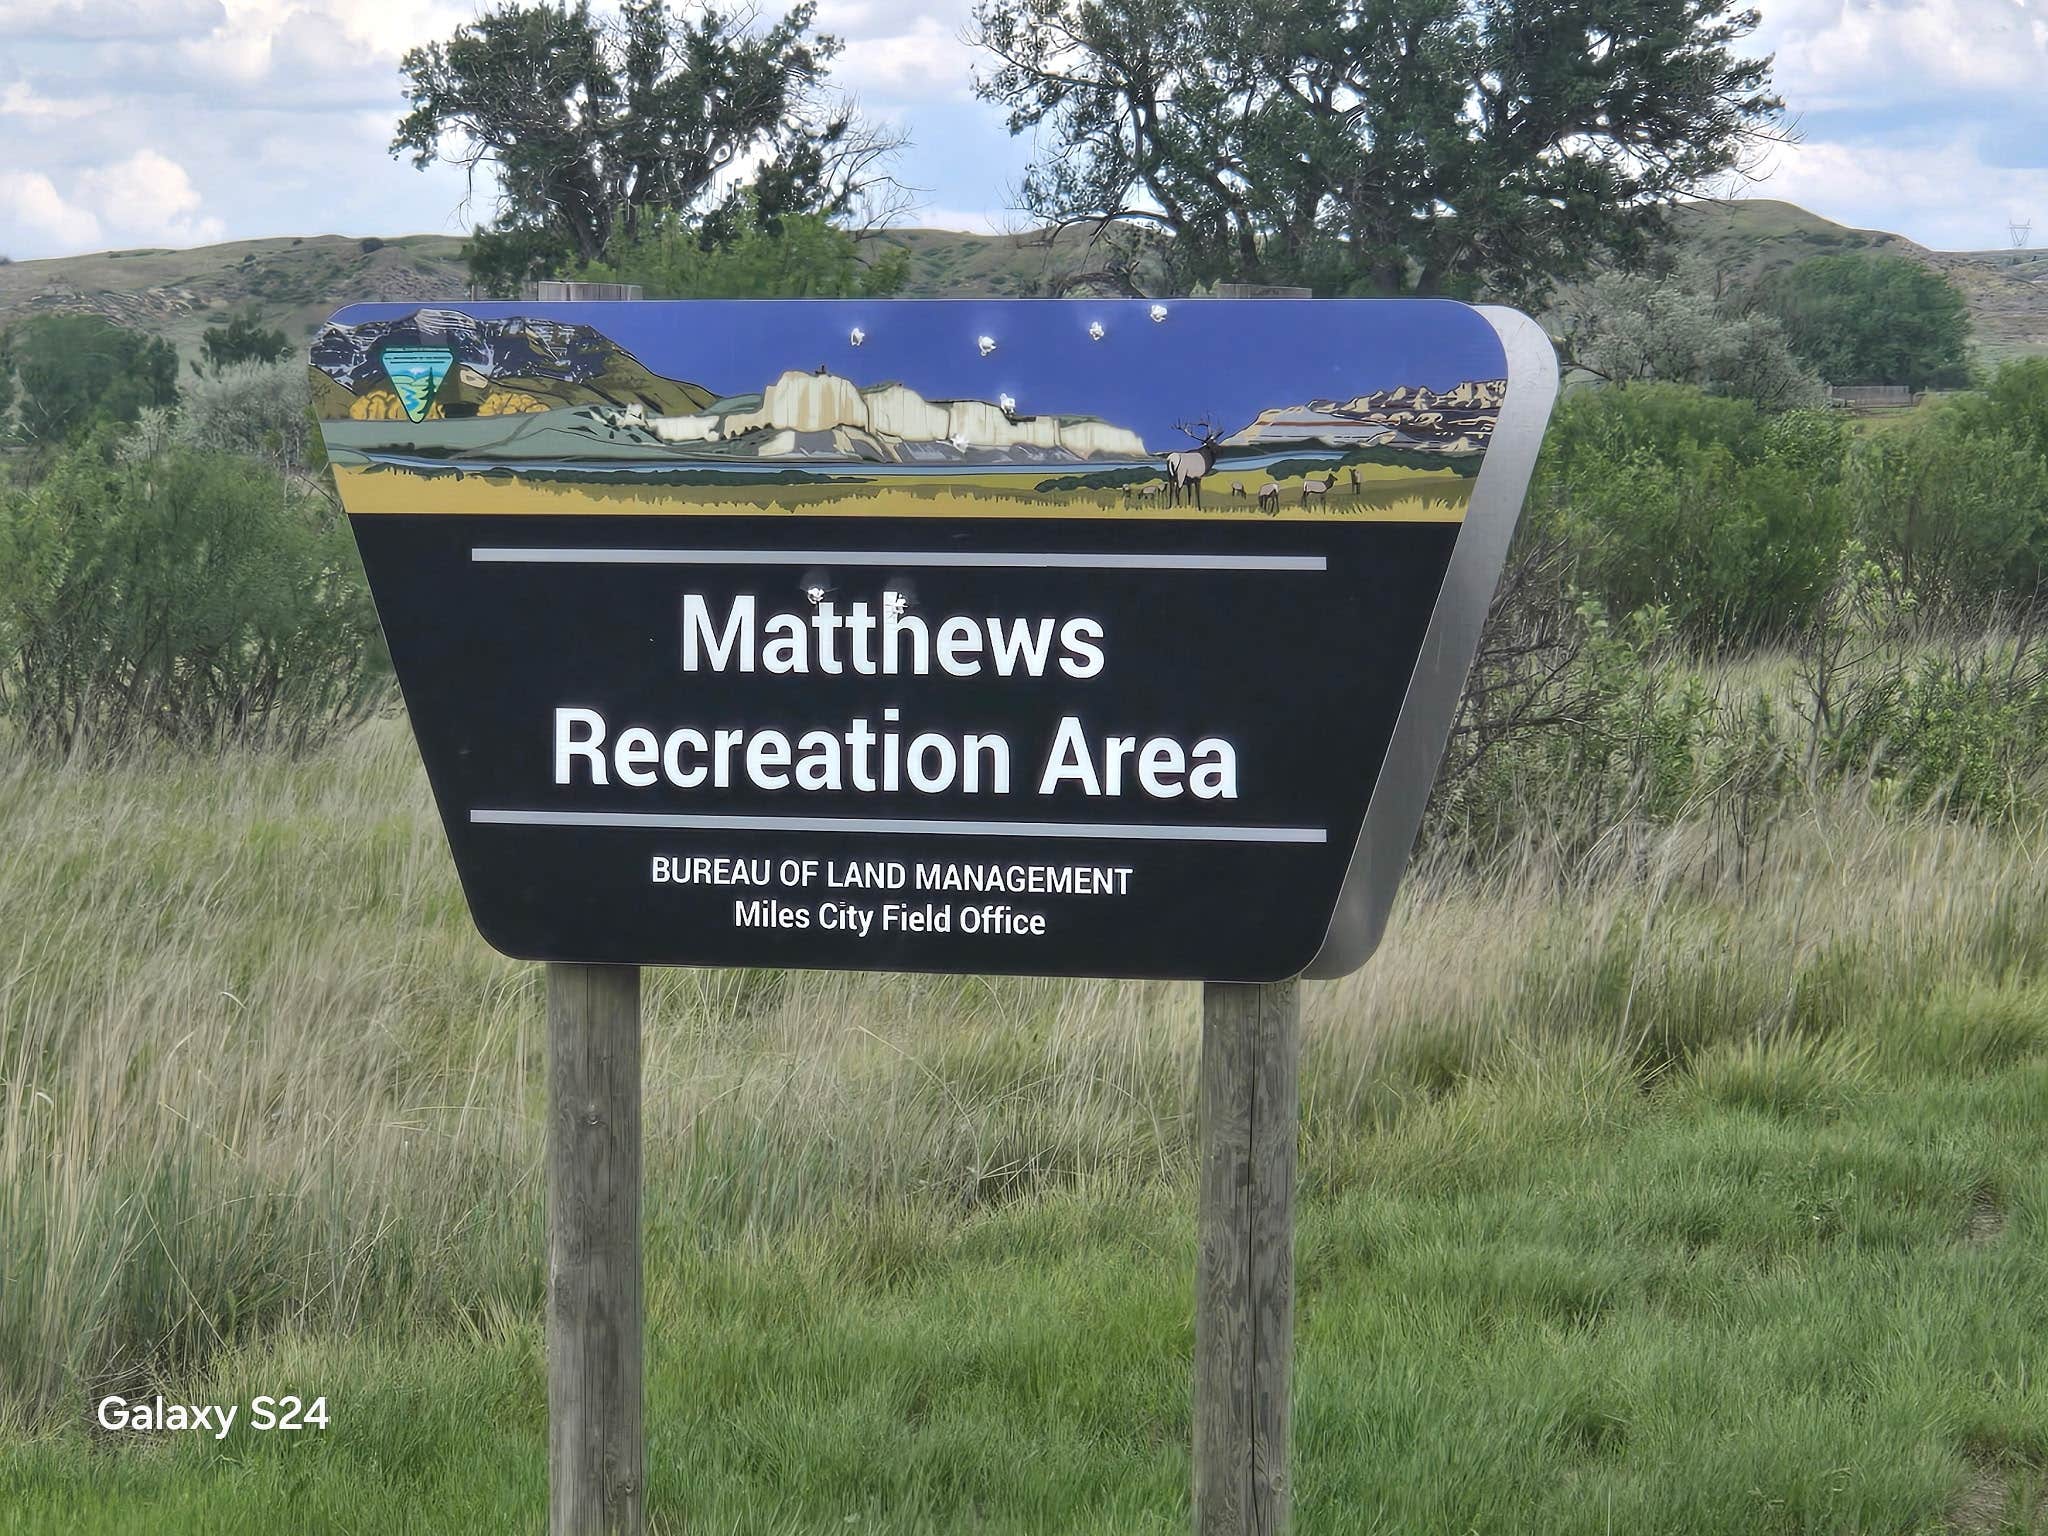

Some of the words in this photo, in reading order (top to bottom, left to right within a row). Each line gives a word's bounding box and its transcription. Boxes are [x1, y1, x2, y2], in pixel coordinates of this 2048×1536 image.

[682, 591, 1105, 679] Matthews
[554, 707, 1010, 794] Recreation
[1038, 716, 1239, 799] Area
[651, 856, 771, 886] BUREAU
[779, 859, 819, 887] OF
[827, 861, 906, 889] LAND
[915, 863, 1134, 895] MANAGEMENT
[735, 899, 810, 929] Miles
[818, 901, 874, 938] City
[882, 903, 951, 933] Field
[959, 905, 1046, 936] Office
